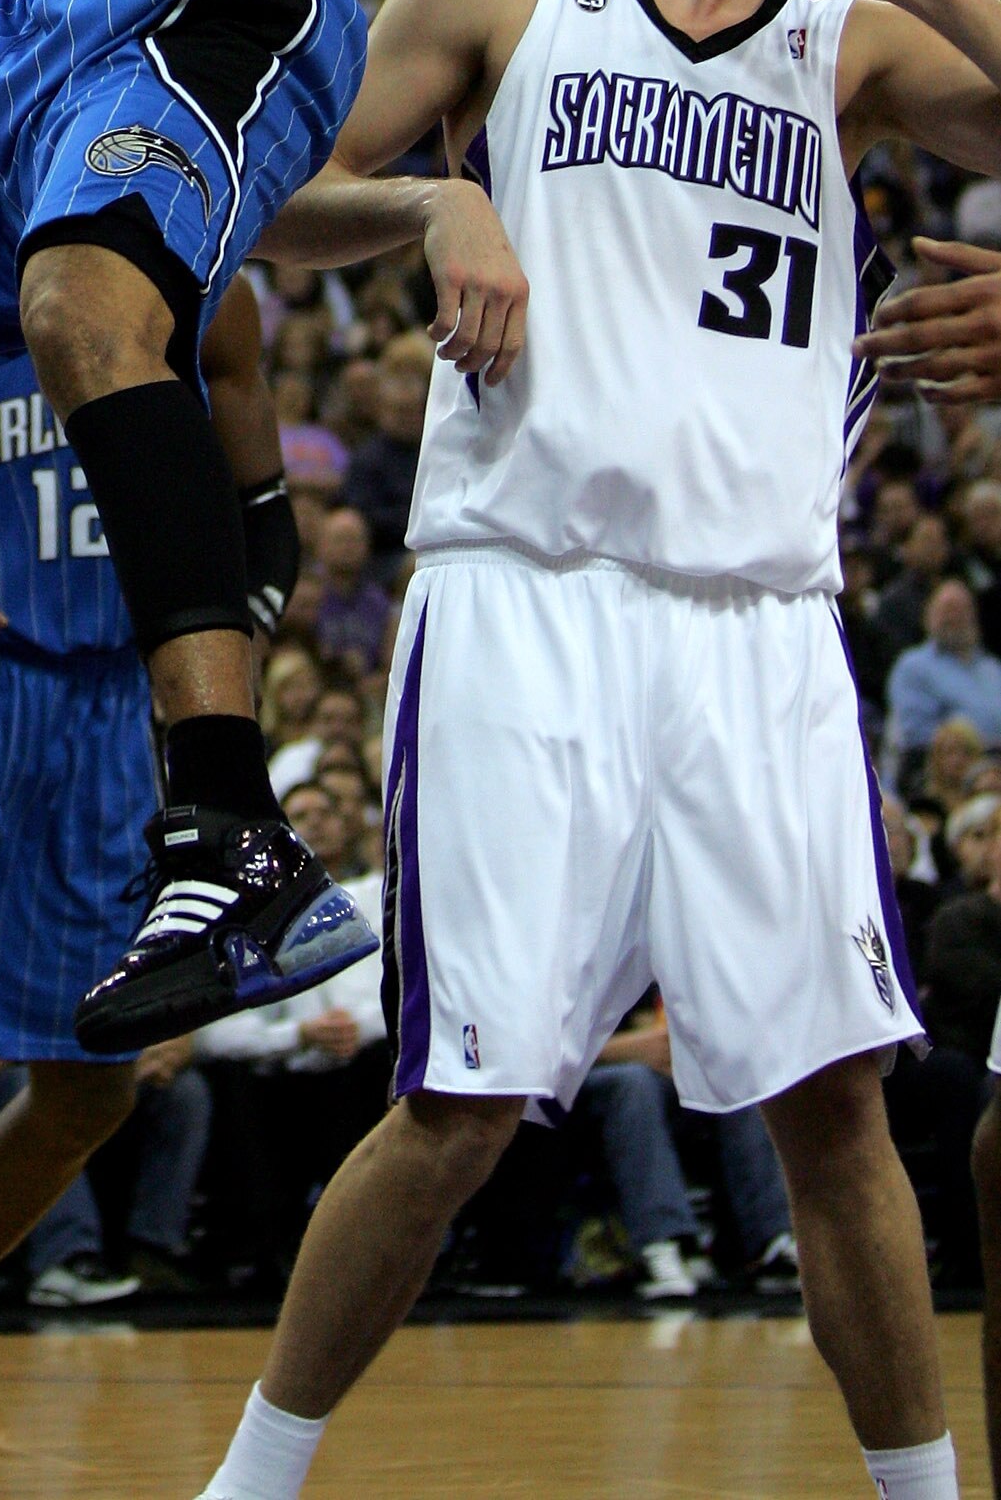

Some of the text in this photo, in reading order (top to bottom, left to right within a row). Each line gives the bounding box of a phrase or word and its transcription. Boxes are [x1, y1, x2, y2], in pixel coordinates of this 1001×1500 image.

[540, 68, 821, 232] SACRAMENTO
[697, 222, 818, 348] 31
[31, 466, 110, 561] 12
